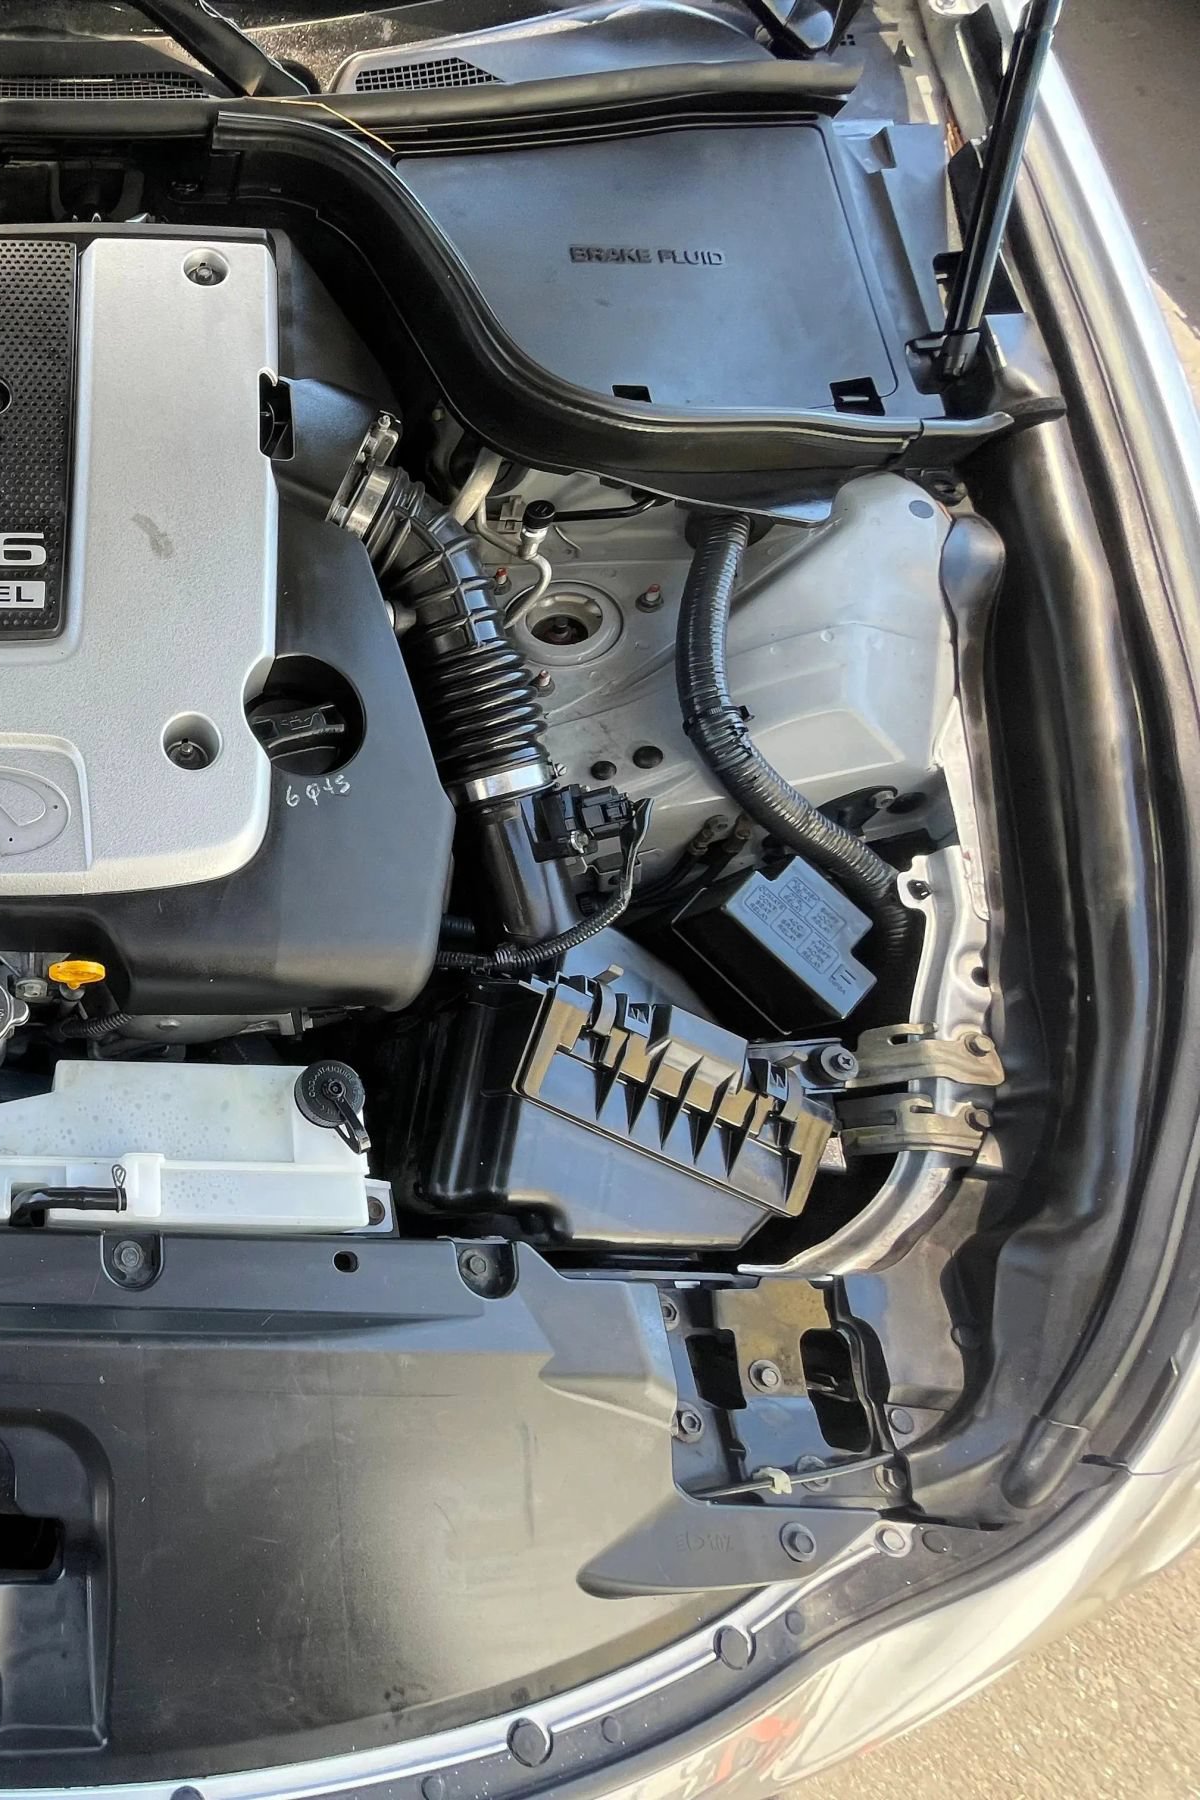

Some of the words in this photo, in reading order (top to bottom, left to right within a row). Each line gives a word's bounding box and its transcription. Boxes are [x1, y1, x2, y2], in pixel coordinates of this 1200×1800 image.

[569, 246, 652, 264] BRAKE
[657, 249, 723, 266] FLUID
[285, 785, 301, 807] 6
